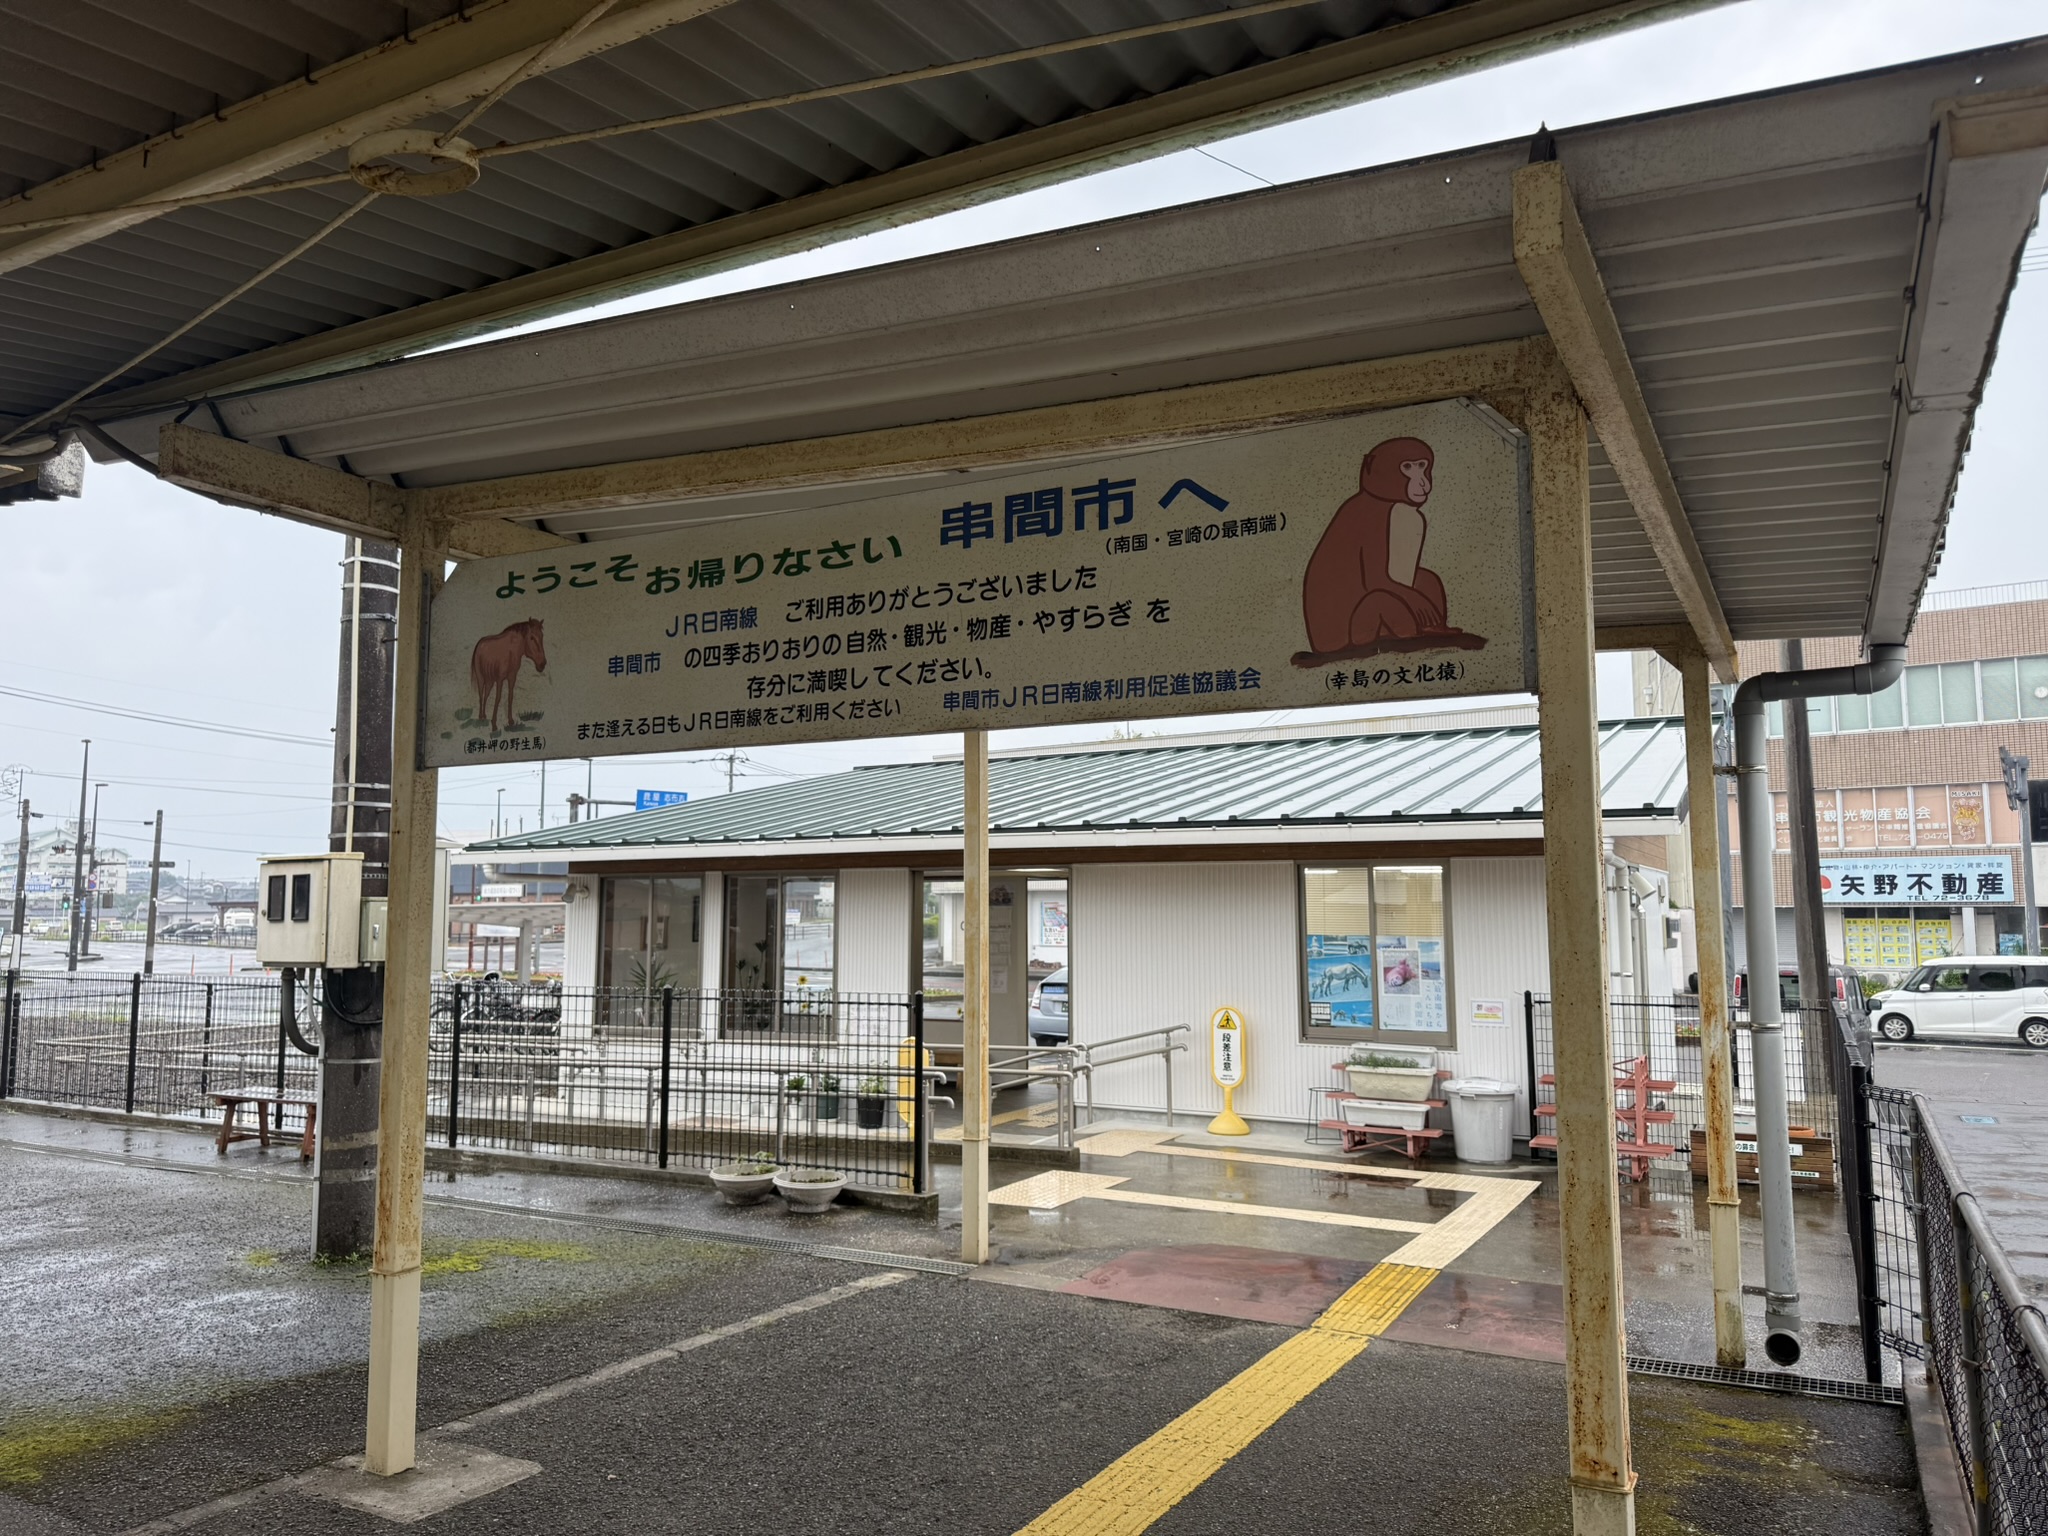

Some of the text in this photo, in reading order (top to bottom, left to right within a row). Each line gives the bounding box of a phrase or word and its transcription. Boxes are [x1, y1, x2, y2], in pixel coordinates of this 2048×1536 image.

[665, 565, 1098, 638] JR日南線 ご利用ありがとうございました
[607, 651, 662, 678] 串間市
[746, 656, 992, 700] 存分に満喫してください。
[1324, 661, 1466, 691] （幸島の文化猿）
[576, 666, 1262, 741] また逢える日もJR日南線をご利用ください 串間市JR日南線利用促進協議会
[1951, 790, 1981, 798] MISAKI
[1840, 872, 2005, 896] 矢野不動産
[1222, 1033, 1232, 1072] 段差注意
